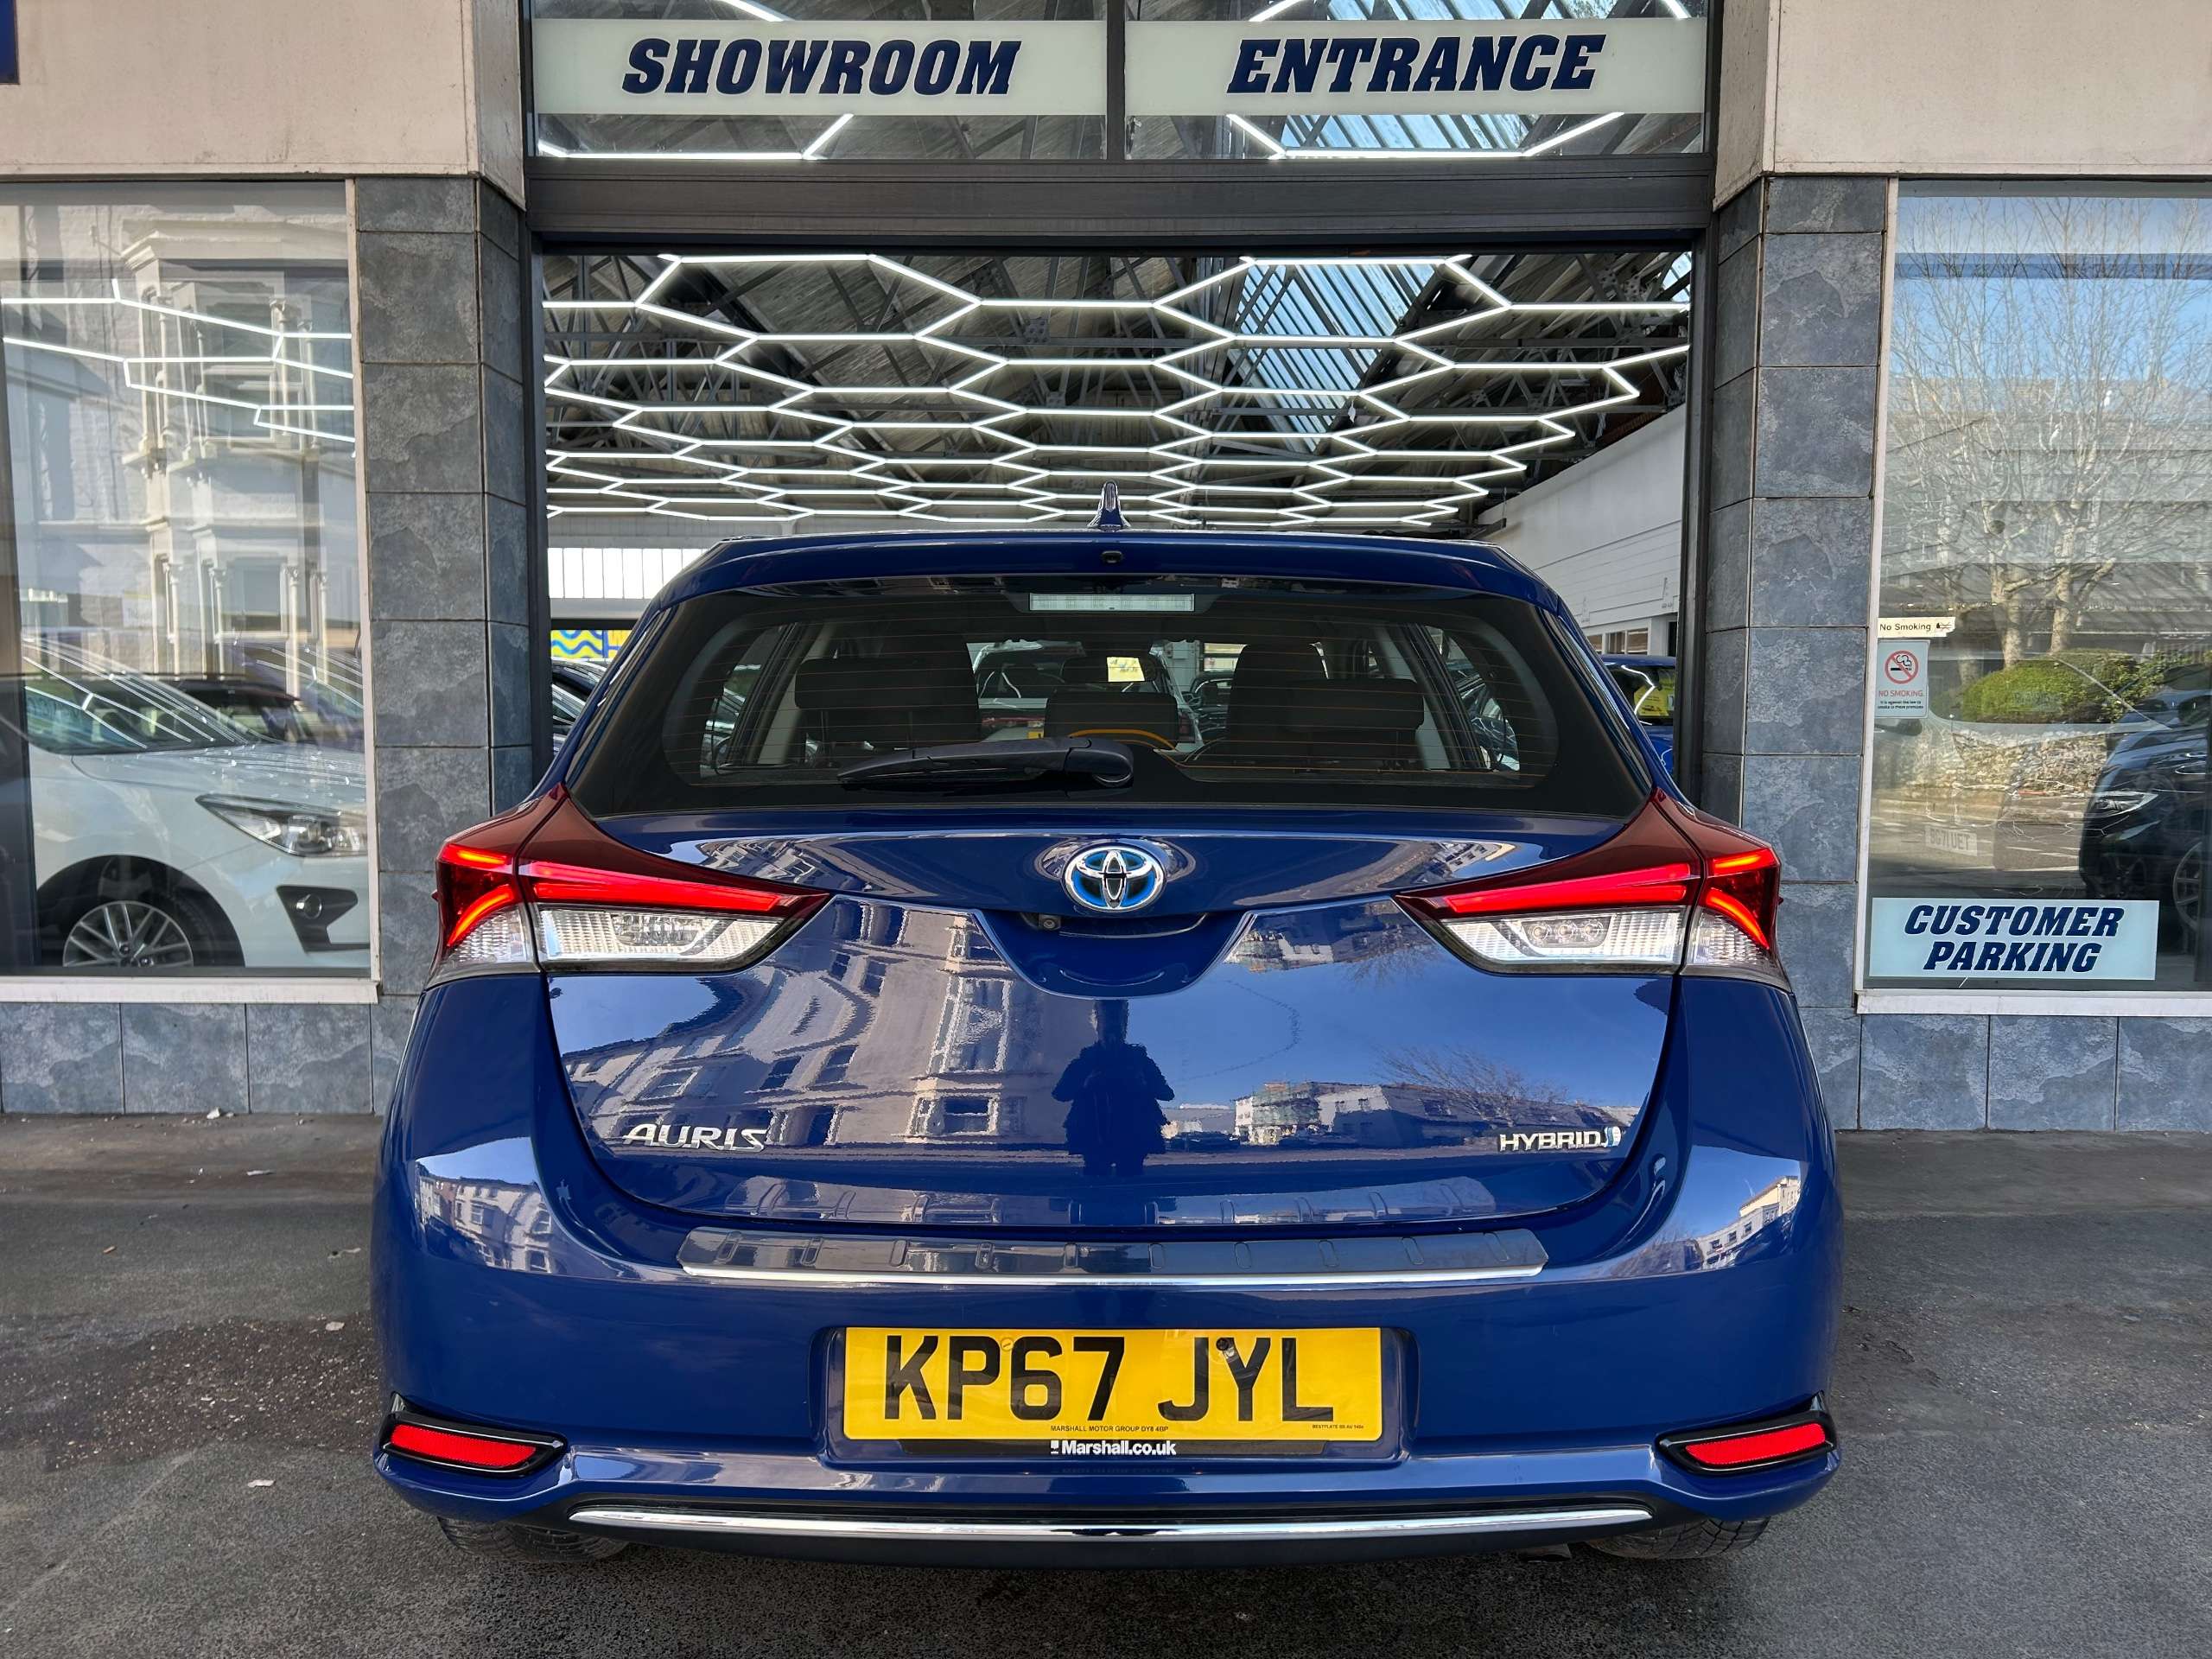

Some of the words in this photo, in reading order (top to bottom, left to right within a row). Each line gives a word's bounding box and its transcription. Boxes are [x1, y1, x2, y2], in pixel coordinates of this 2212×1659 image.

[621, 37, 1022, 96] SHOWROOM
[1225, 34, 1606, 94] ENTRANCE
[1879, 623, 1892, 632] No
[1894, 622, 1932, 632] Smoking
[1904, 904, 2125, 938] CUSTOMER
[1923, 941, 2102, 973] PARKING
[622, 1123, 767, 1153] AURIS
[1499, 1129, 1600, 1152] HYBRID
[883, 1334, 1126, 1421] KP67
[1157, 1336, 1334, 1422] JYL
[1061, 1440, 1177, 1456] Marshall.co.uk
